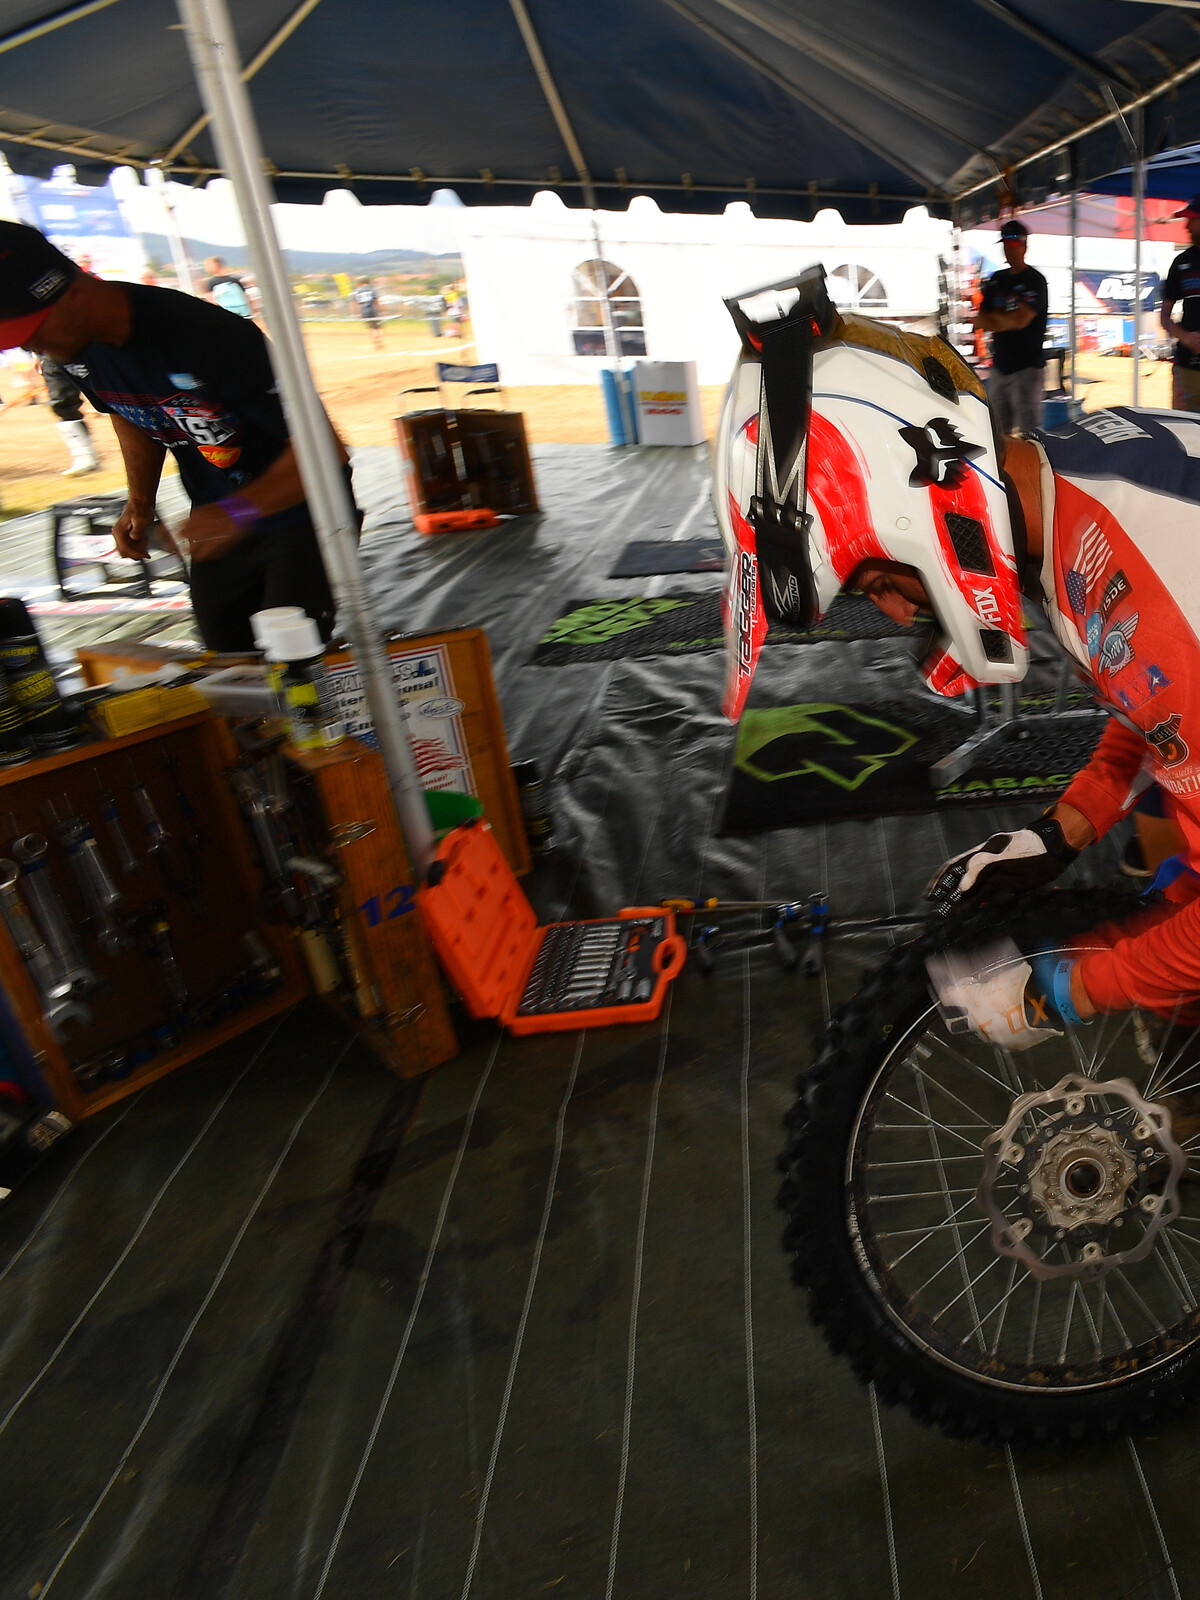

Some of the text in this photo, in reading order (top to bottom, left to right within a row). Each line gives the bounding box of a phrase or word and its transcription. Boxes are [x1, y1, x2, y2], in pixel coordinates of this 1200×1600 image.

[971, 586, 1002, 623] FOX
[355, 885, 417, 928] 12
[977, 994, 1049, 1041] FOX
